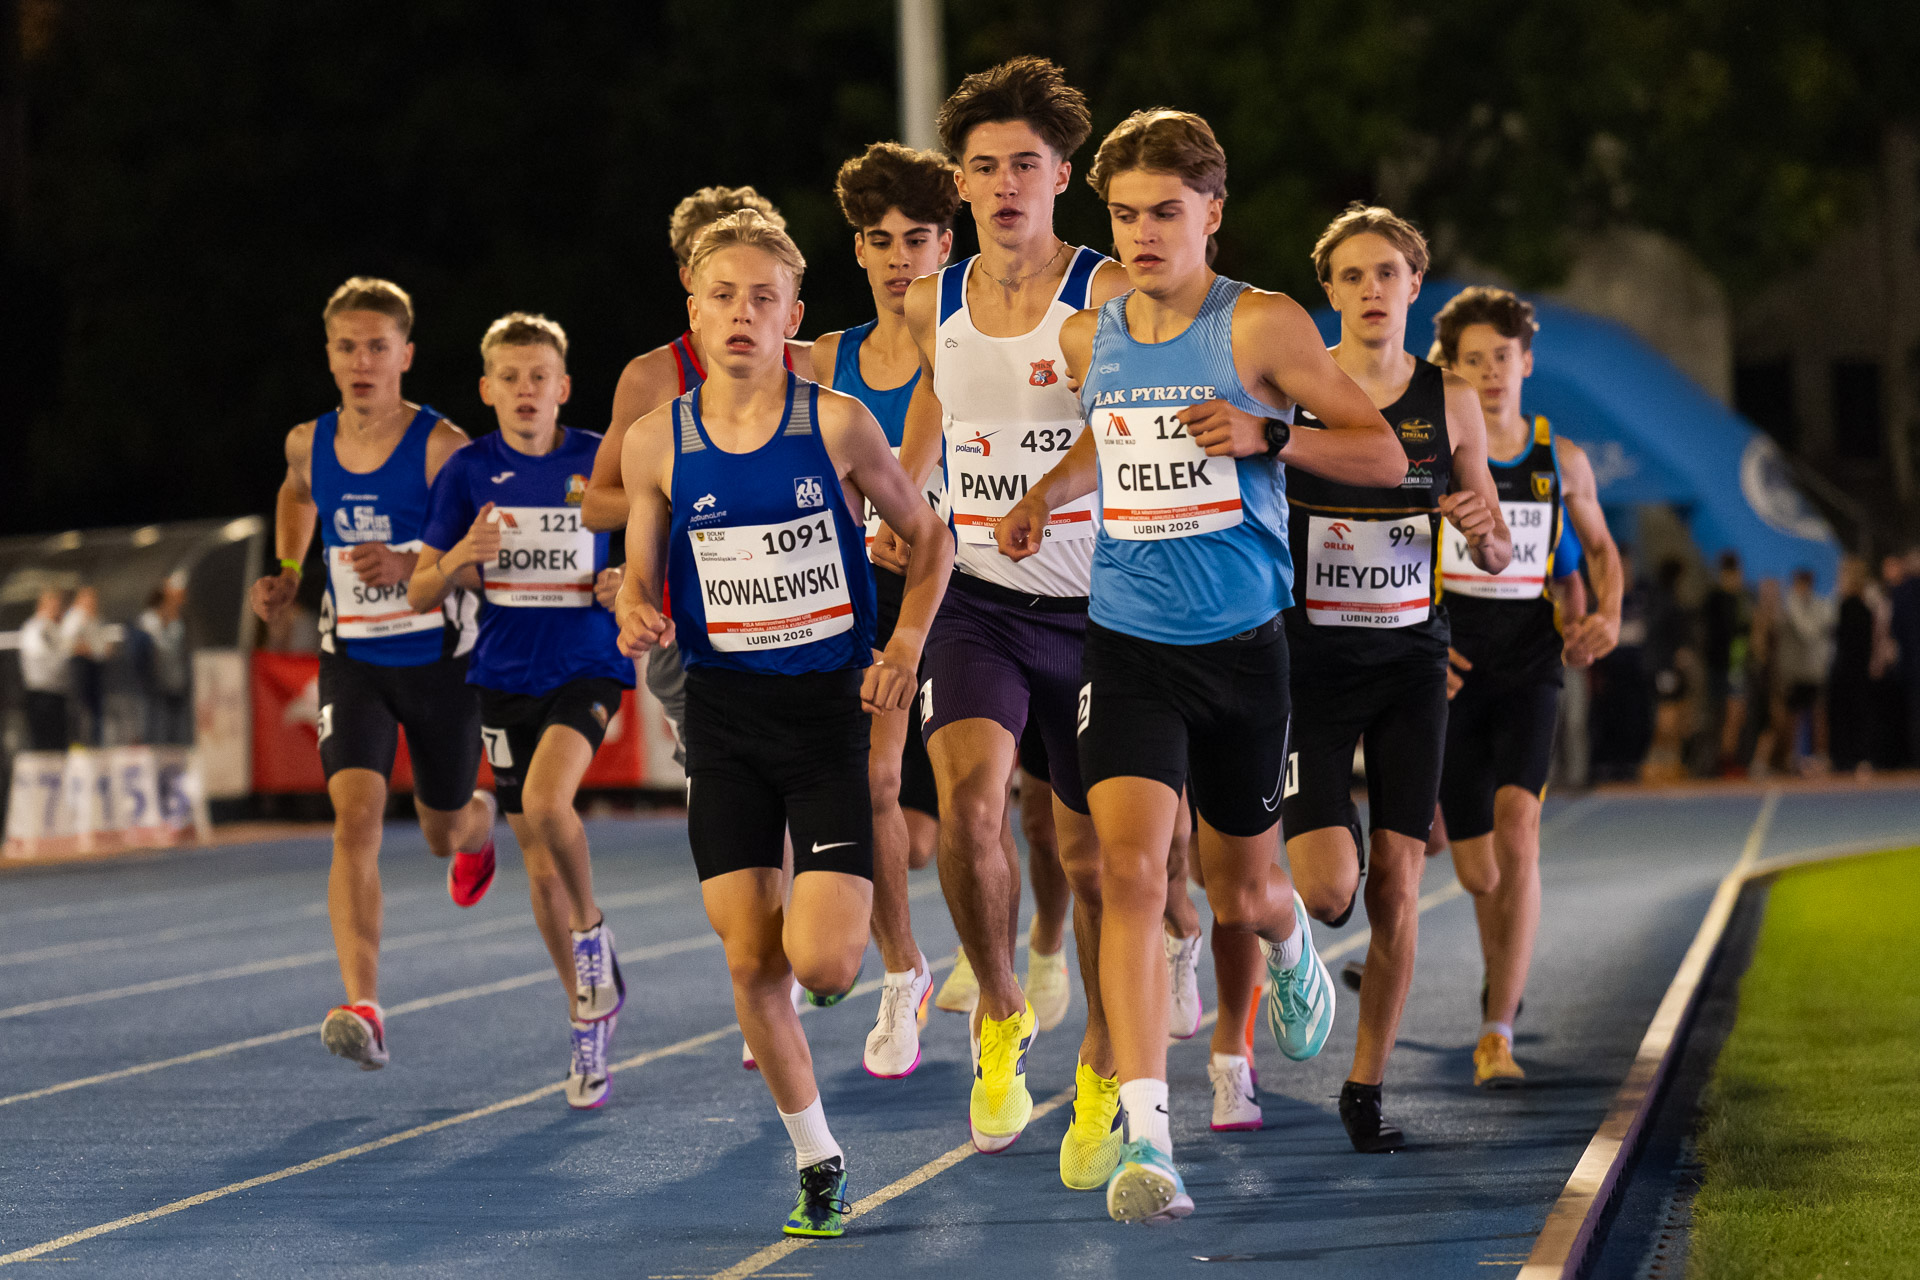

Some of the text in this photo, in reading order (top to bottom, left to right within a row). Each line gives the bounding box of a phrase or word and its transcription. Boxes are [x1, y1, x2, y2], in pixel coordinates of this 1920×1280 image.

[1130, 385, 1216, 402] PYRZYCE
[955, 444, 981, 454] polanik
[1020, 428, 1072, 452] 432
[1118, 459, 1212, 491] CIELEK
[540, 514, 584, 533] 121
[1134, 520, 1199, 534] LUBIN 2026
[762, 520, 833, 556] 1091
[1323, 542, 1354, 551] ORLEN
[1389, 525, 1415, 547] 99
[498, 549, 577, 570] BOREK
[706, 563, 840, 606] KOWALEWSKI
[1316, 562, 1422, 589] HEYDUK
[353, 580, 409, 604] SOPA
[1341, 614, 1399, 624] LUBIN 2026
[746, 628, 813, 645] LUBIN 2026
[484, 733, 498, 763] 7
